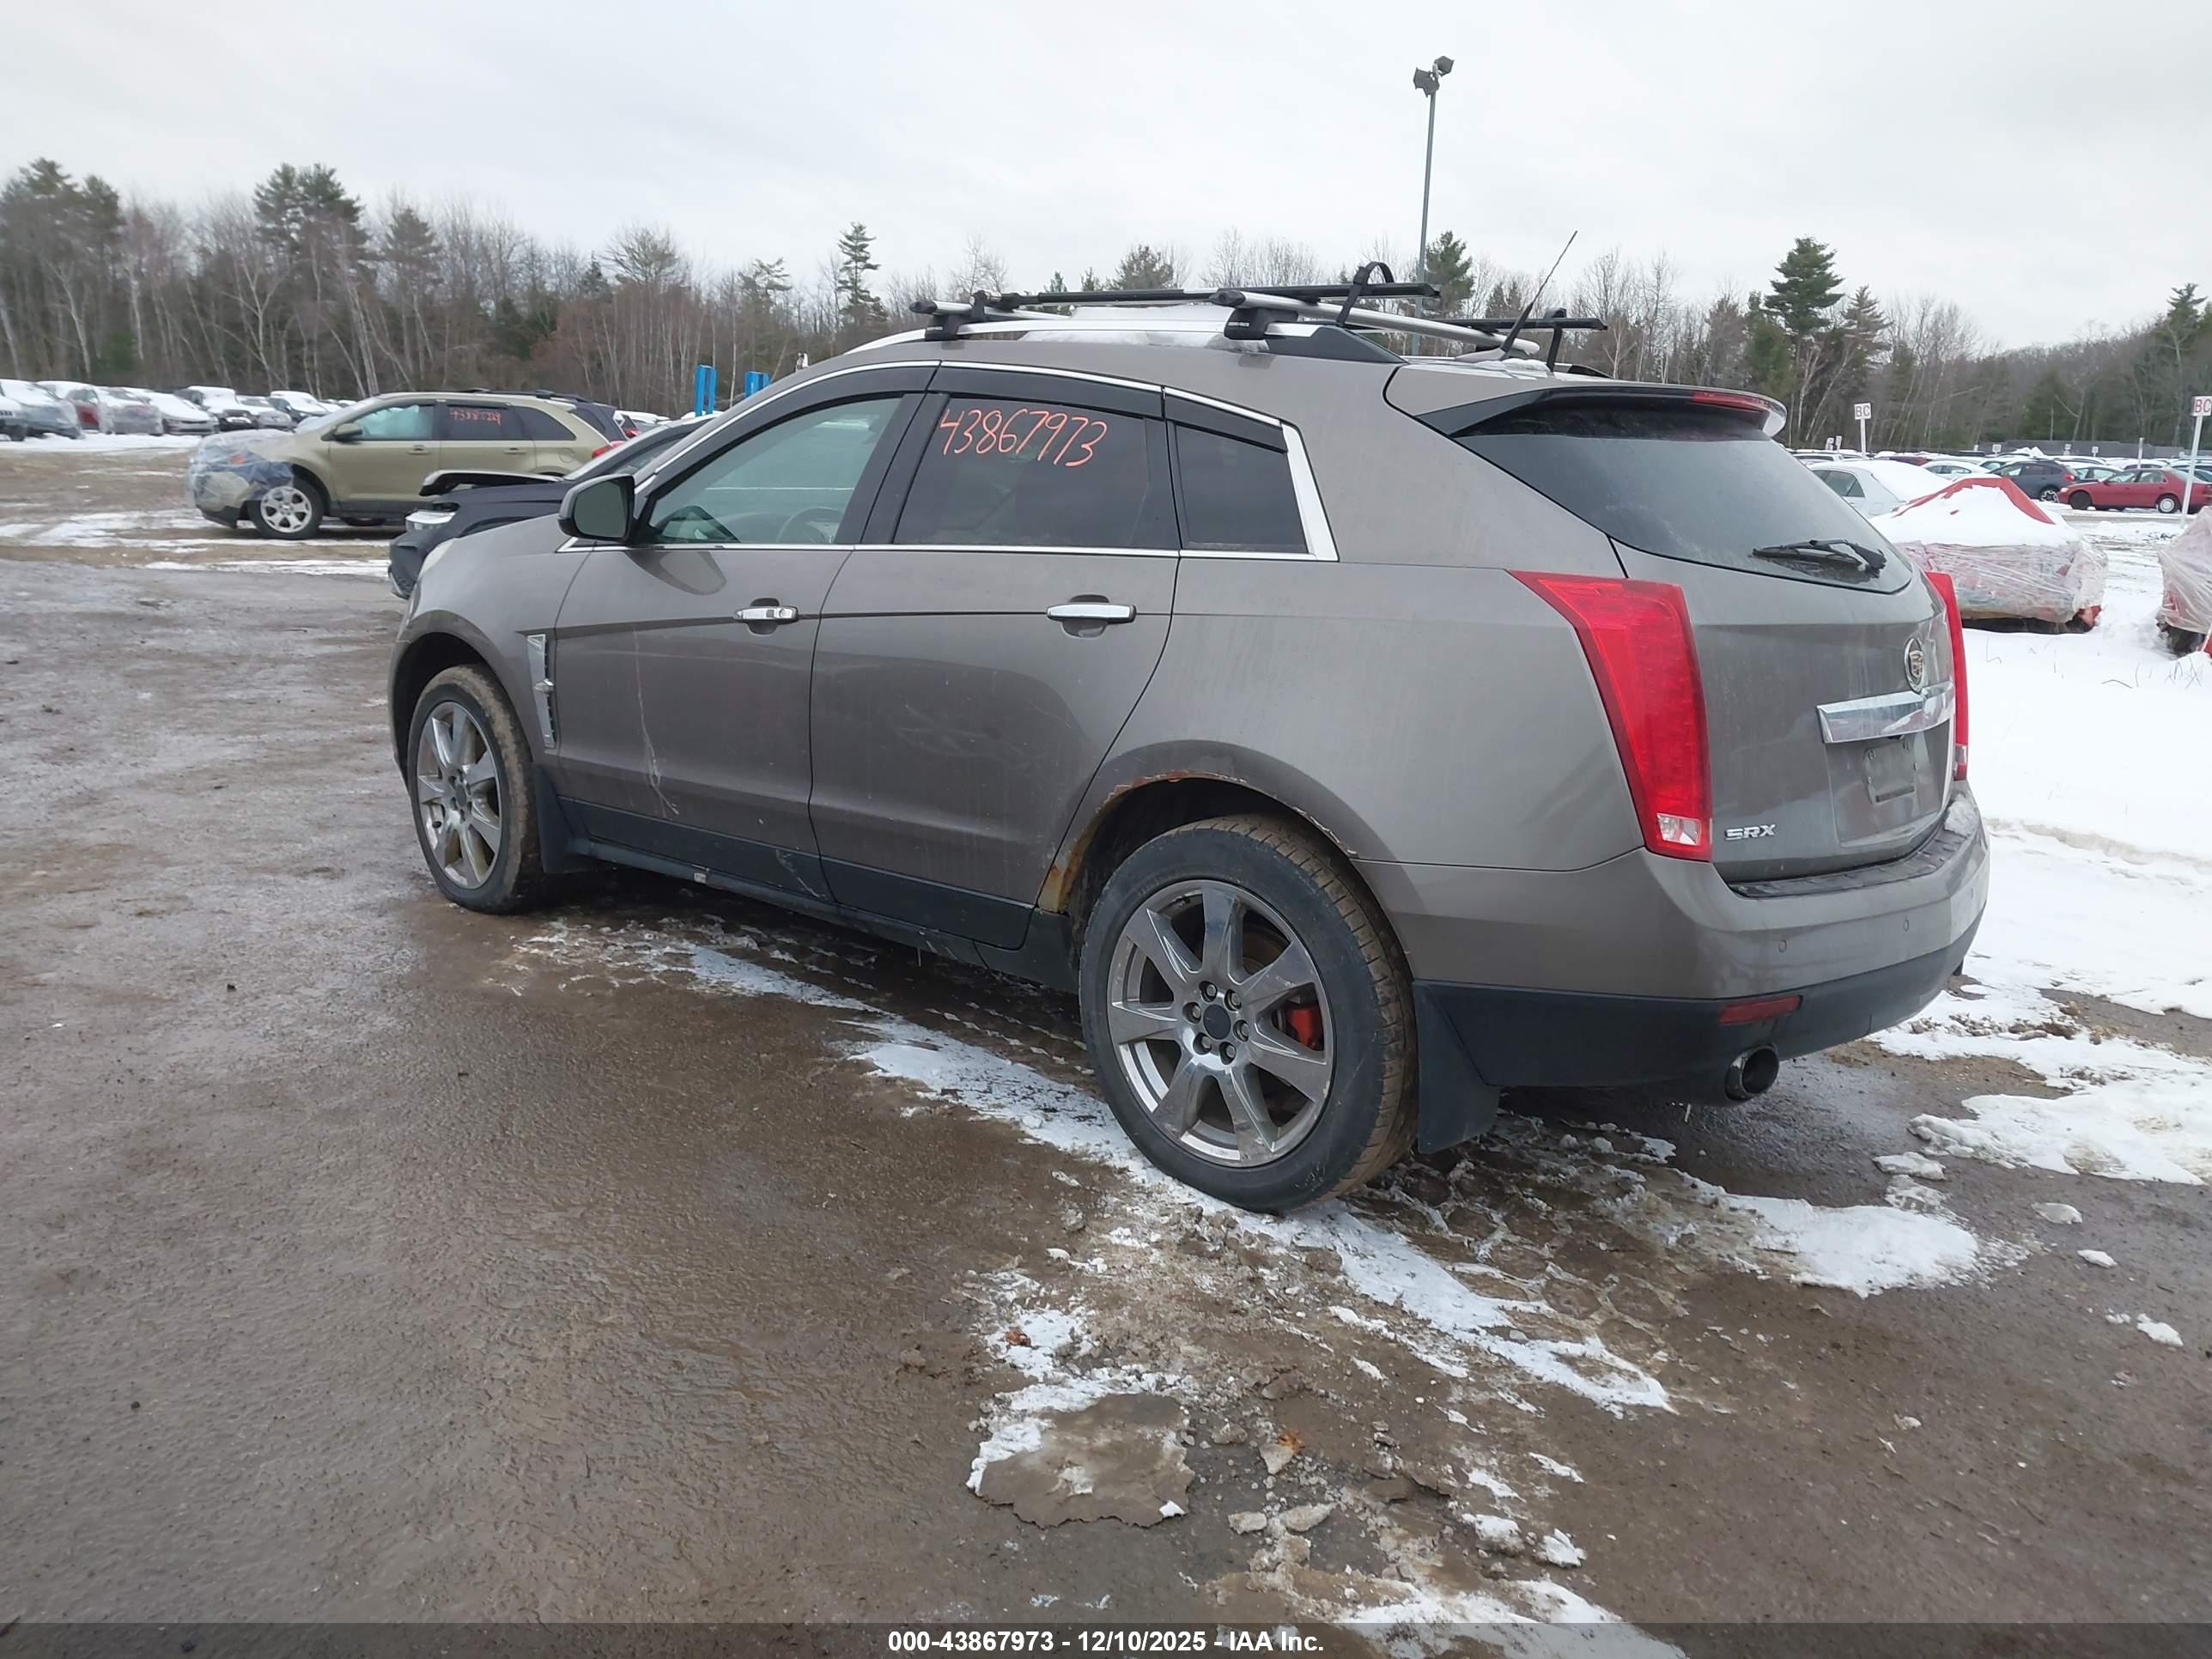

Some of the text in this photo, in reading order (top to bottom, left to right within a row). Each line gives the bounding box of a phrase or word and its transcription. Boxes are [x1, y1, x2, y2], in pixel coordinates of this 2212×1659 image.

[1855, 404, 1870, 417] BC
[939, 408, 1108, 467] 43867973
[1725, 823, 1776, 841] SRX
